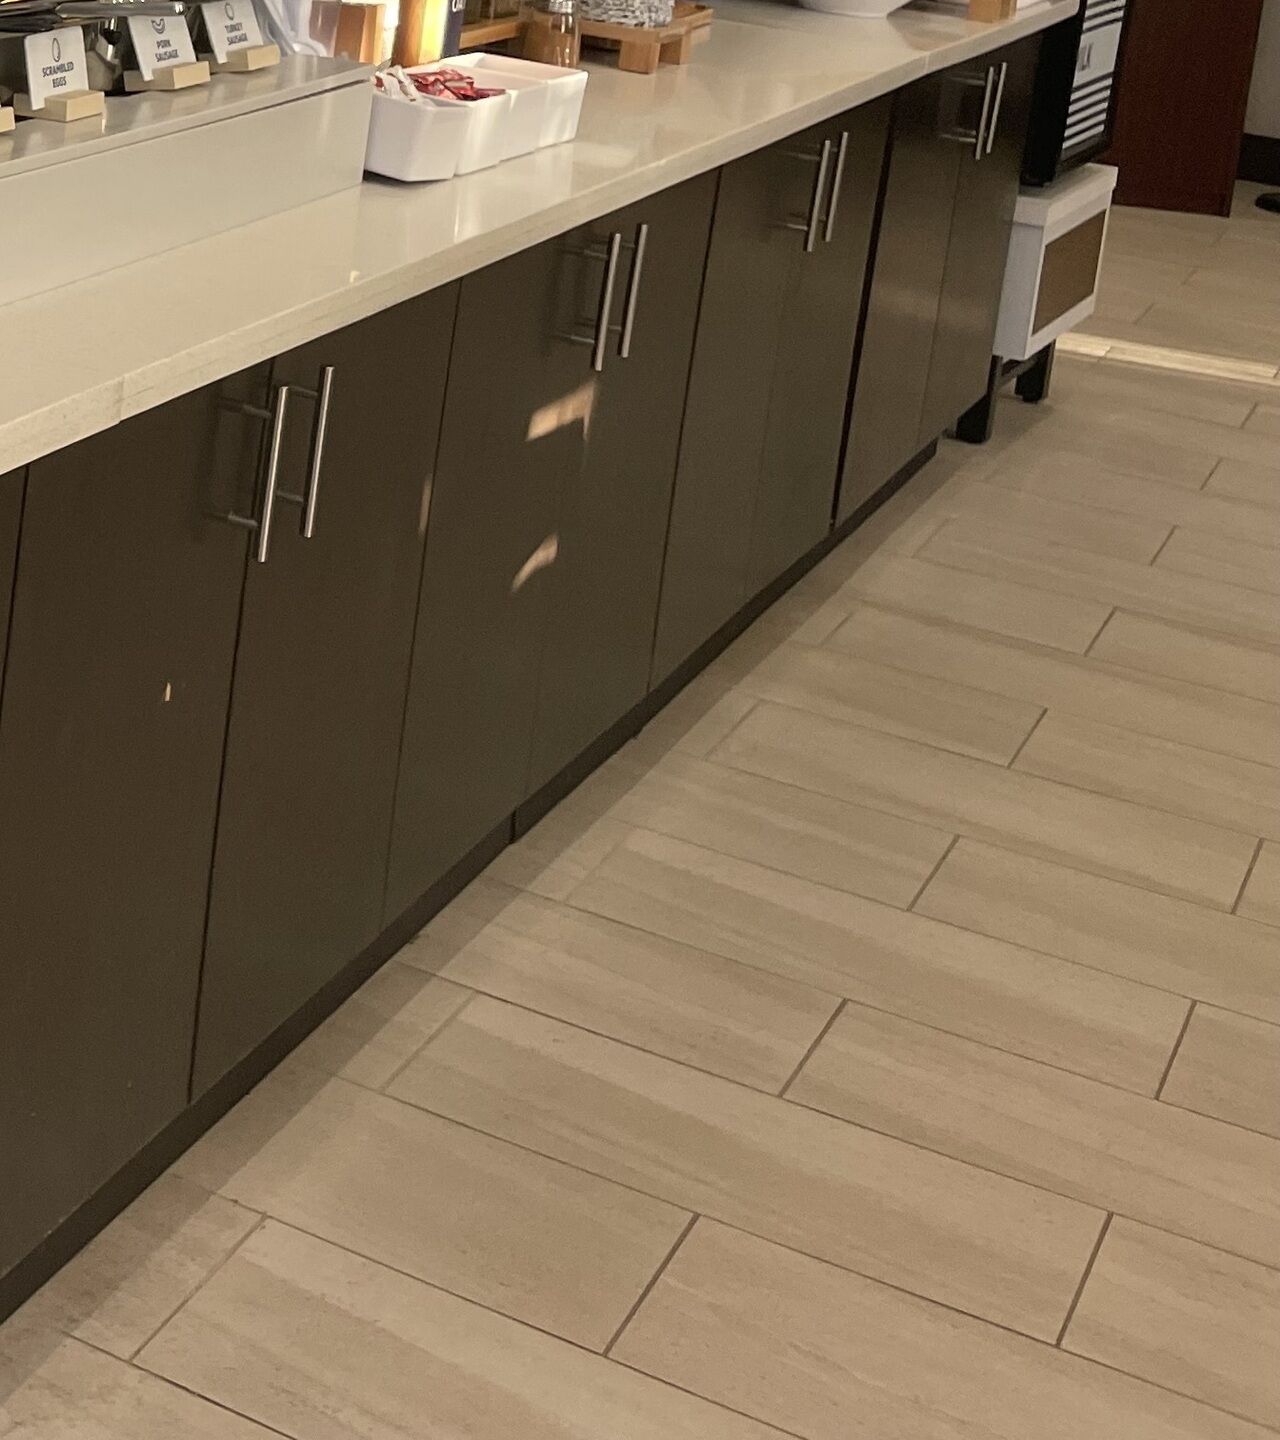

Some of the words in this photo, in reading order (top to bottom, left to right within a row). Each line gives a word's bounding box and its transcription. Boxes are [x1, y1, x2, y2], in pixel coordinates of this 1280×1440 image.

[227, 33, 249, 46] SAUSAGE
[154, 49, 179, 63] SAUSAGE
[42, 61, 74, 78] SCRAMBLED
[52, 76, 67, 89] EGGS
